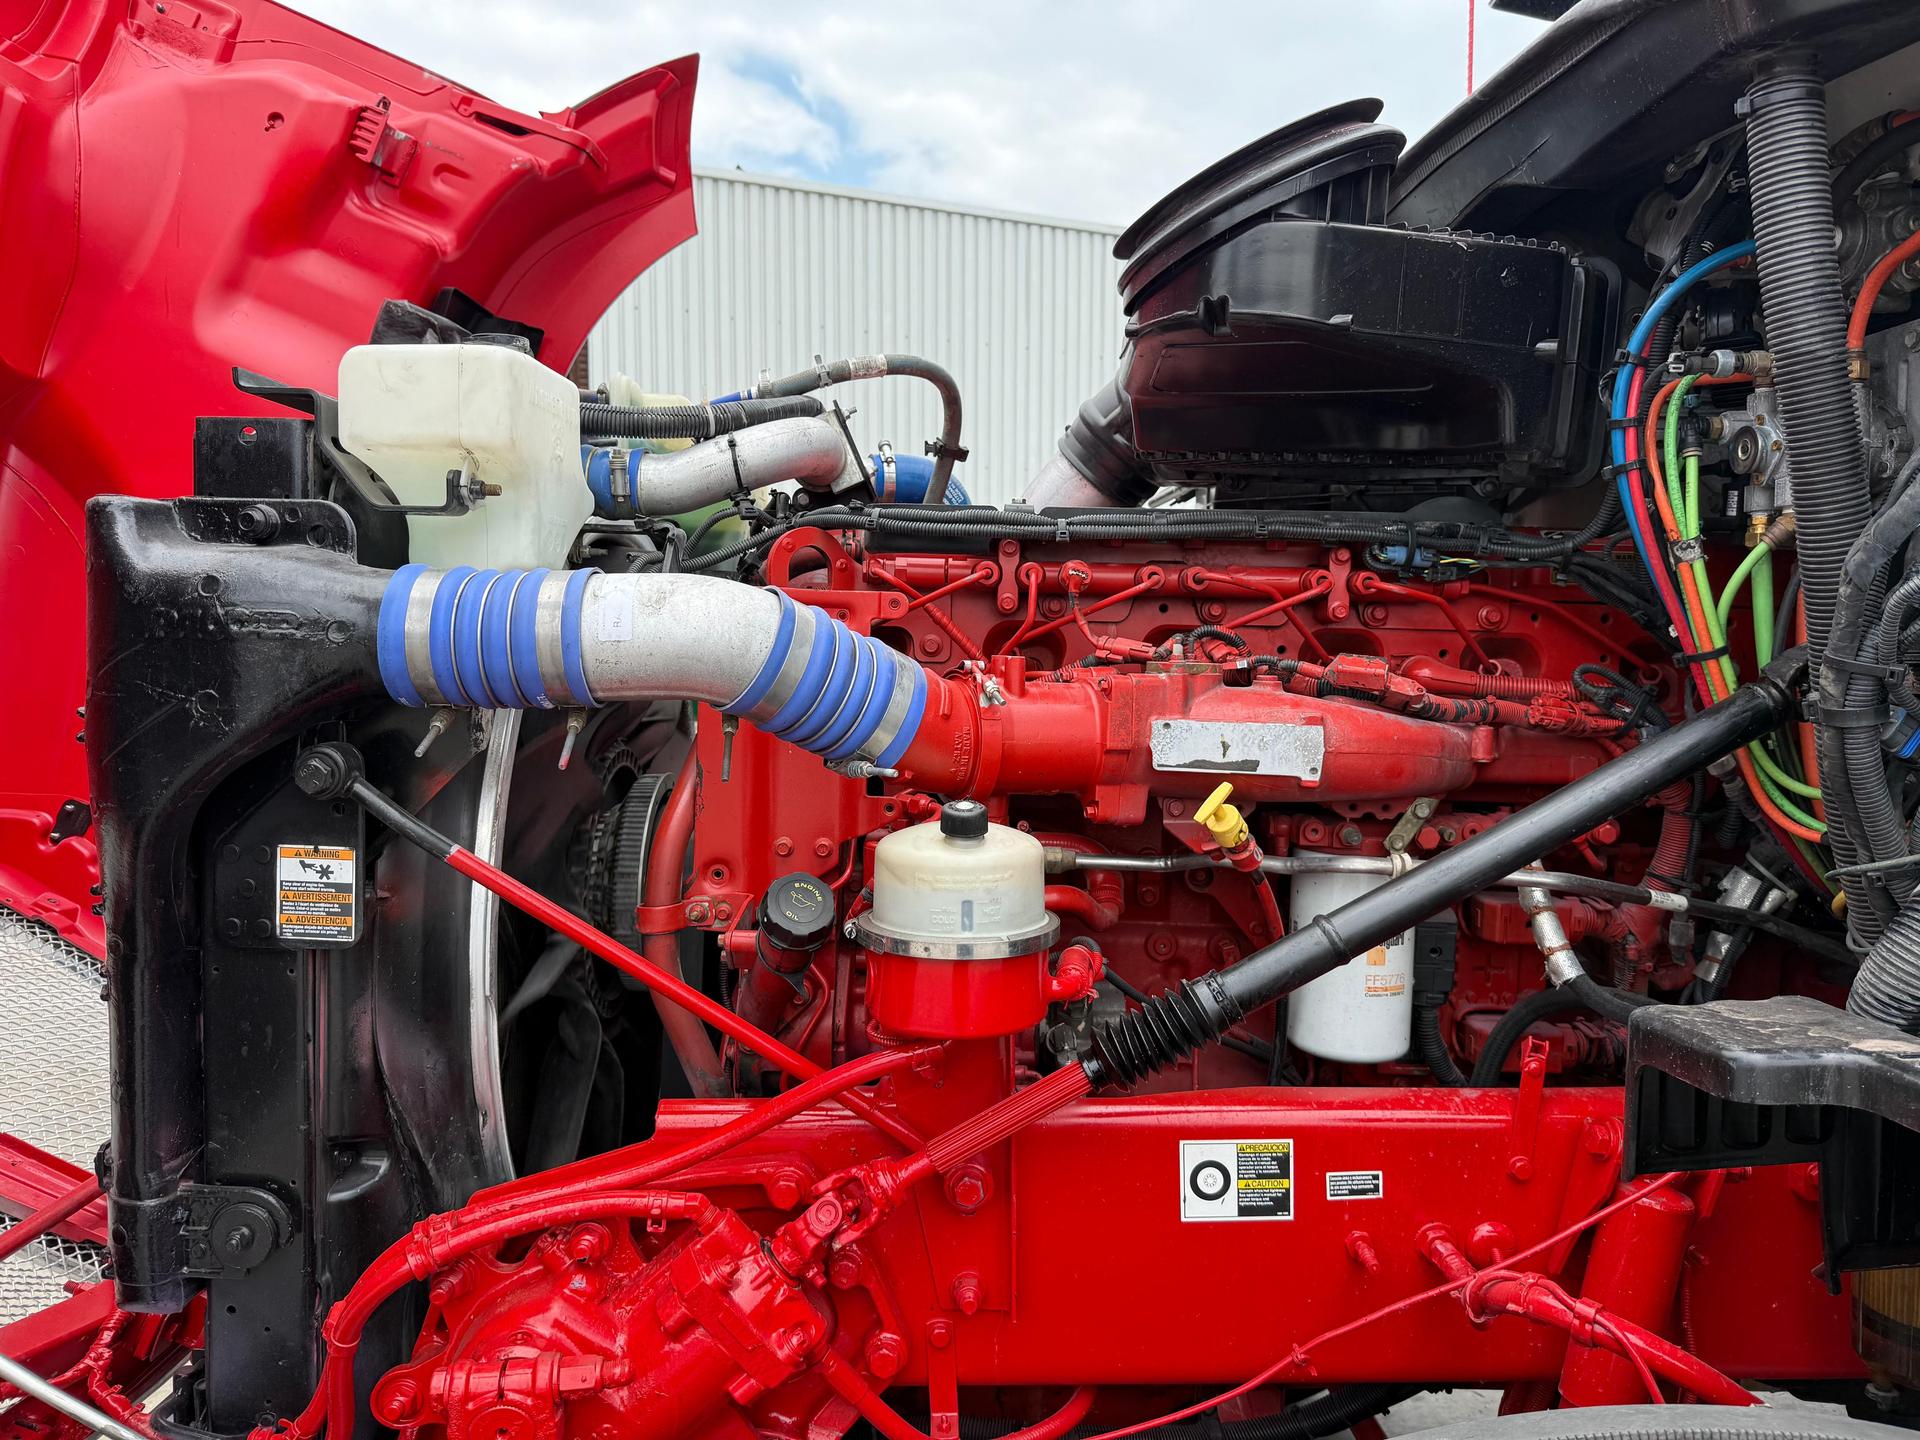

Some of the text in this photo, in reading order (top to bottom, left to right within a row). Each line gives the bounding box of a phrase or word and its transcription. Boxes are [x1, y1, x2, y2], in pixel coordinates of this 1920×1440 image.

[304, 849, 340, 858] WARNING
[292, 892, 351, 902] AVERTISSEMENT
[785, 882, 822, 921] ENGINE OIL
[296, 915, 348, 925] ADVERTENCIA
[1365, 973, 1406, 985] FF5776
[1251, 1180, 1284, 1188] CAUTION
